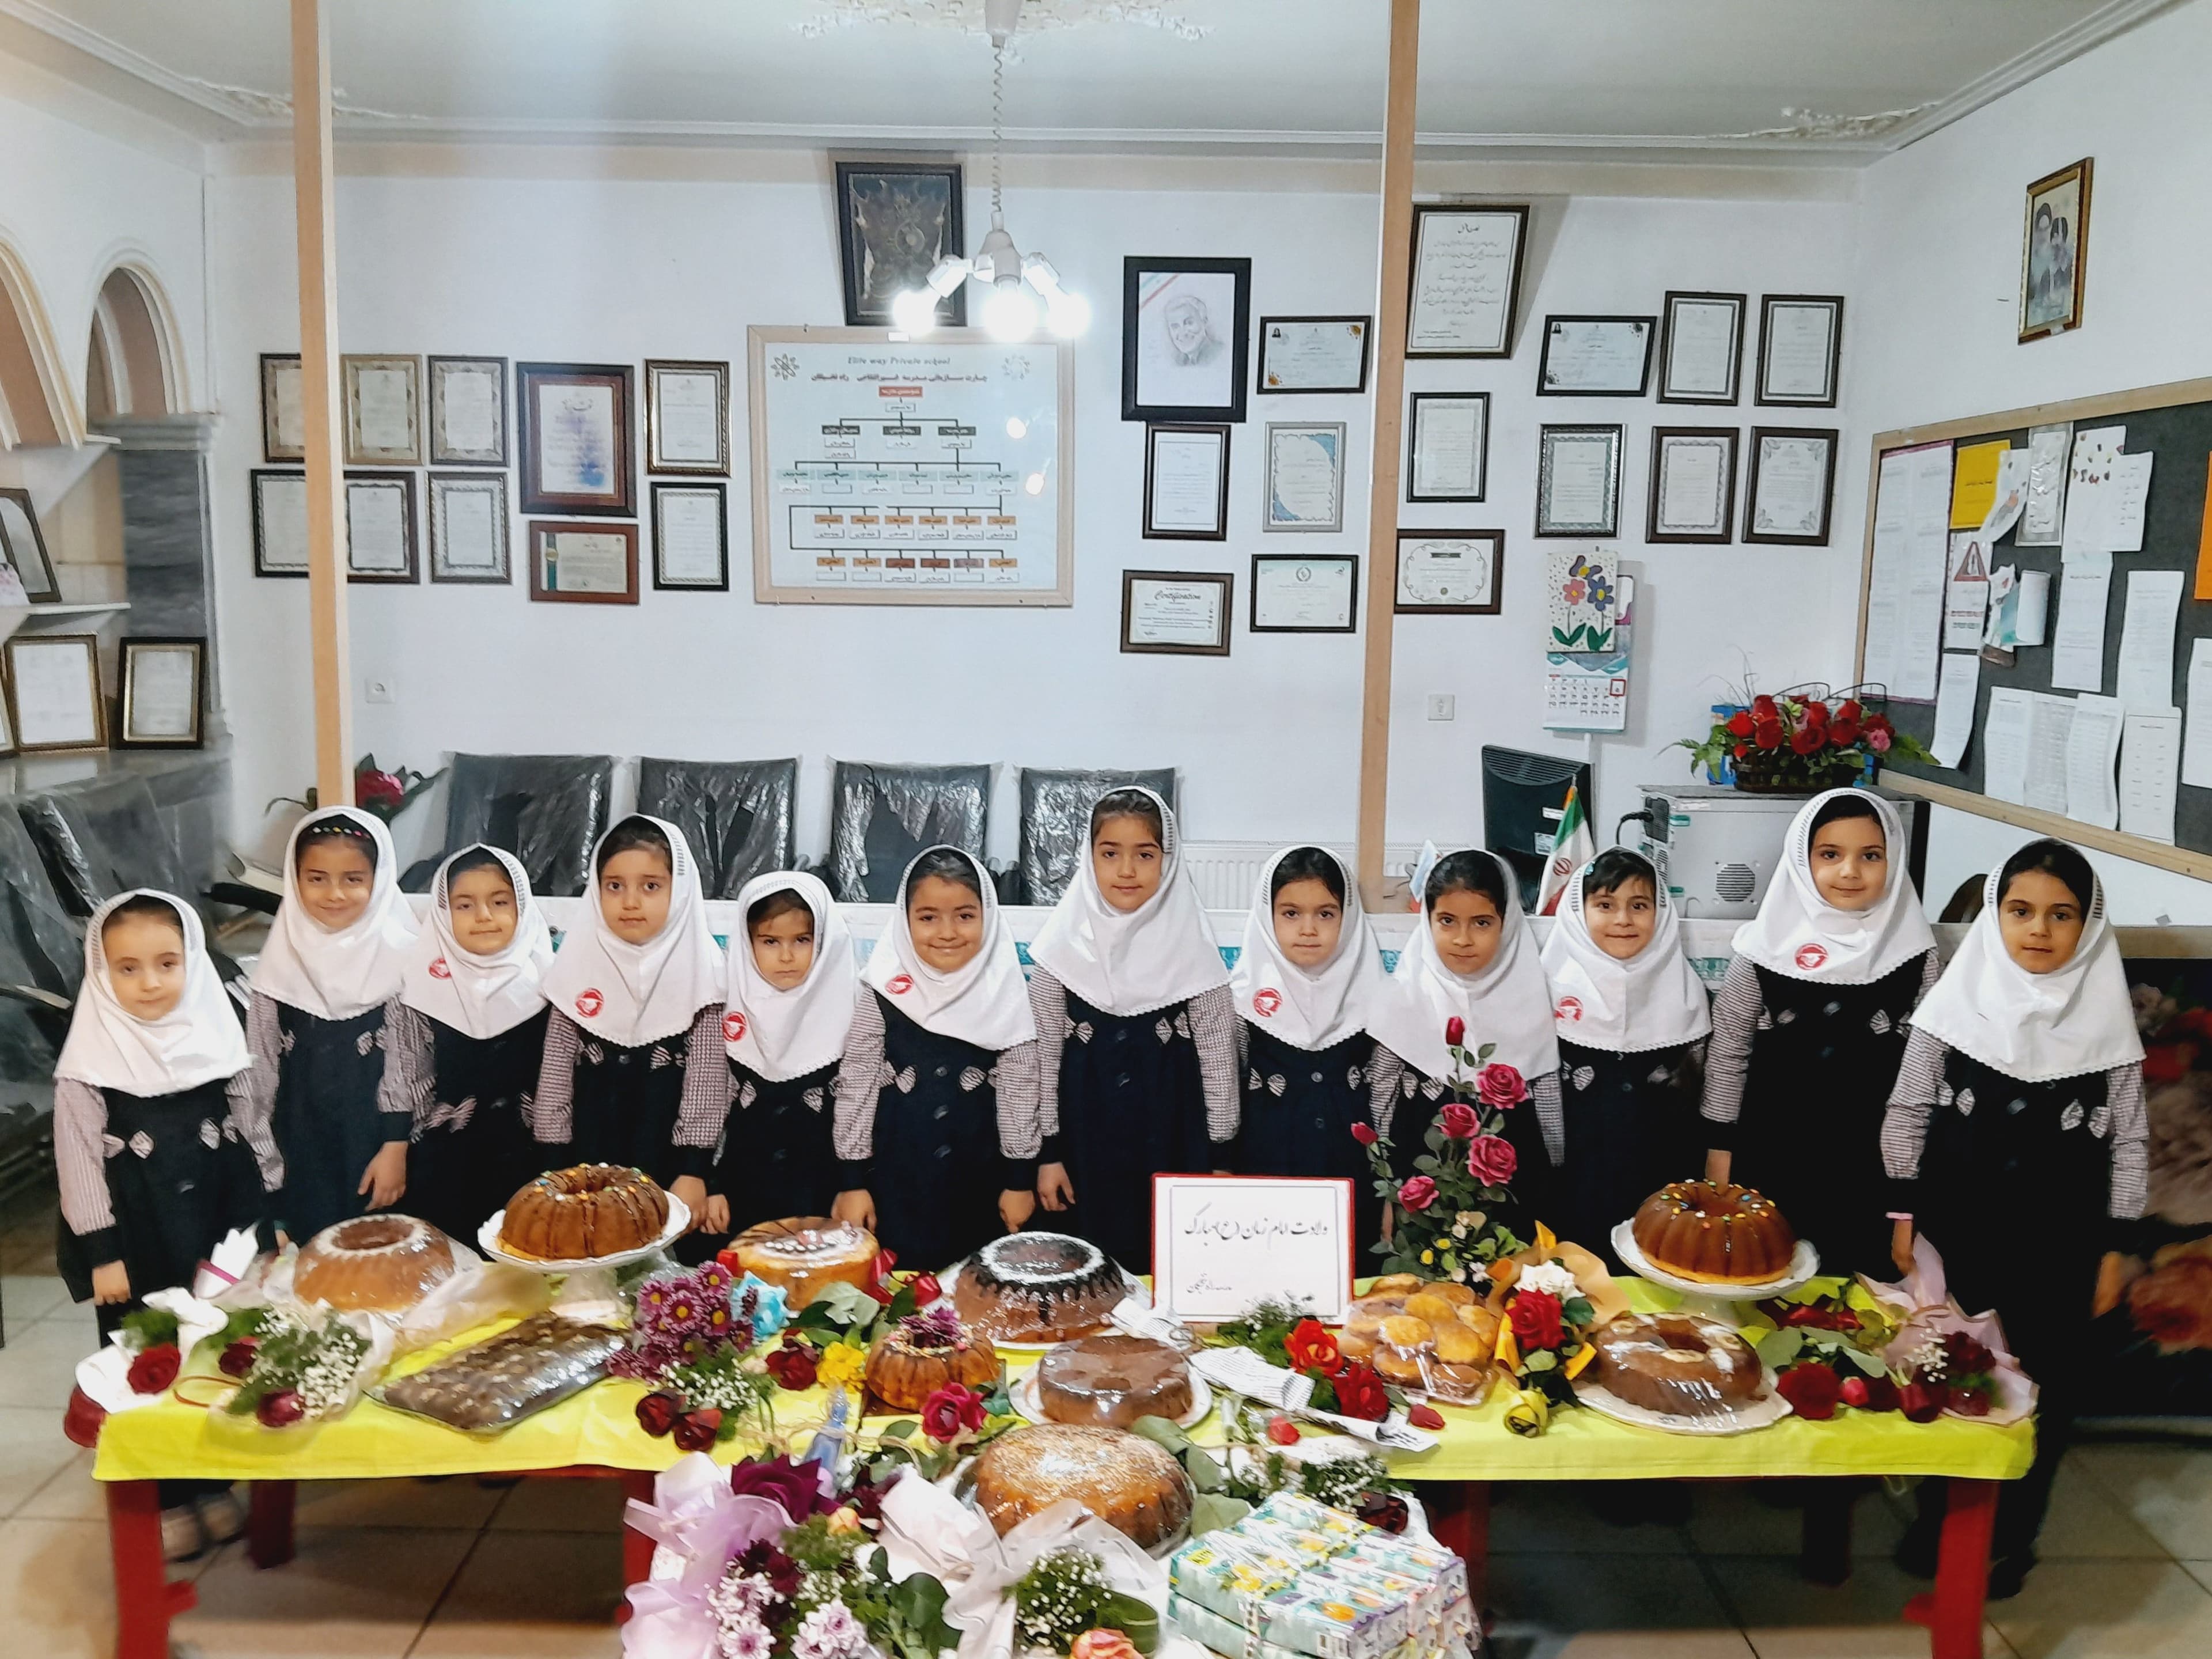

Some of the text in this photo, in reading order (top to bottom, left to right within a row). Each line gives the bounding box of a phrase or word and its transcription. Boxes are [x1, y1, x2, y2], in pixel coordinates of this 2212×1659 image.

[890, 356, 921, 364] Private
[1184, 1200, 1217, 1247] مبارک
[1240, 1216, 1268, 1240] زمان
[1267, 1219, 1289, 1251] امام
[1290, 1218, 1328, 1236] ولادت
